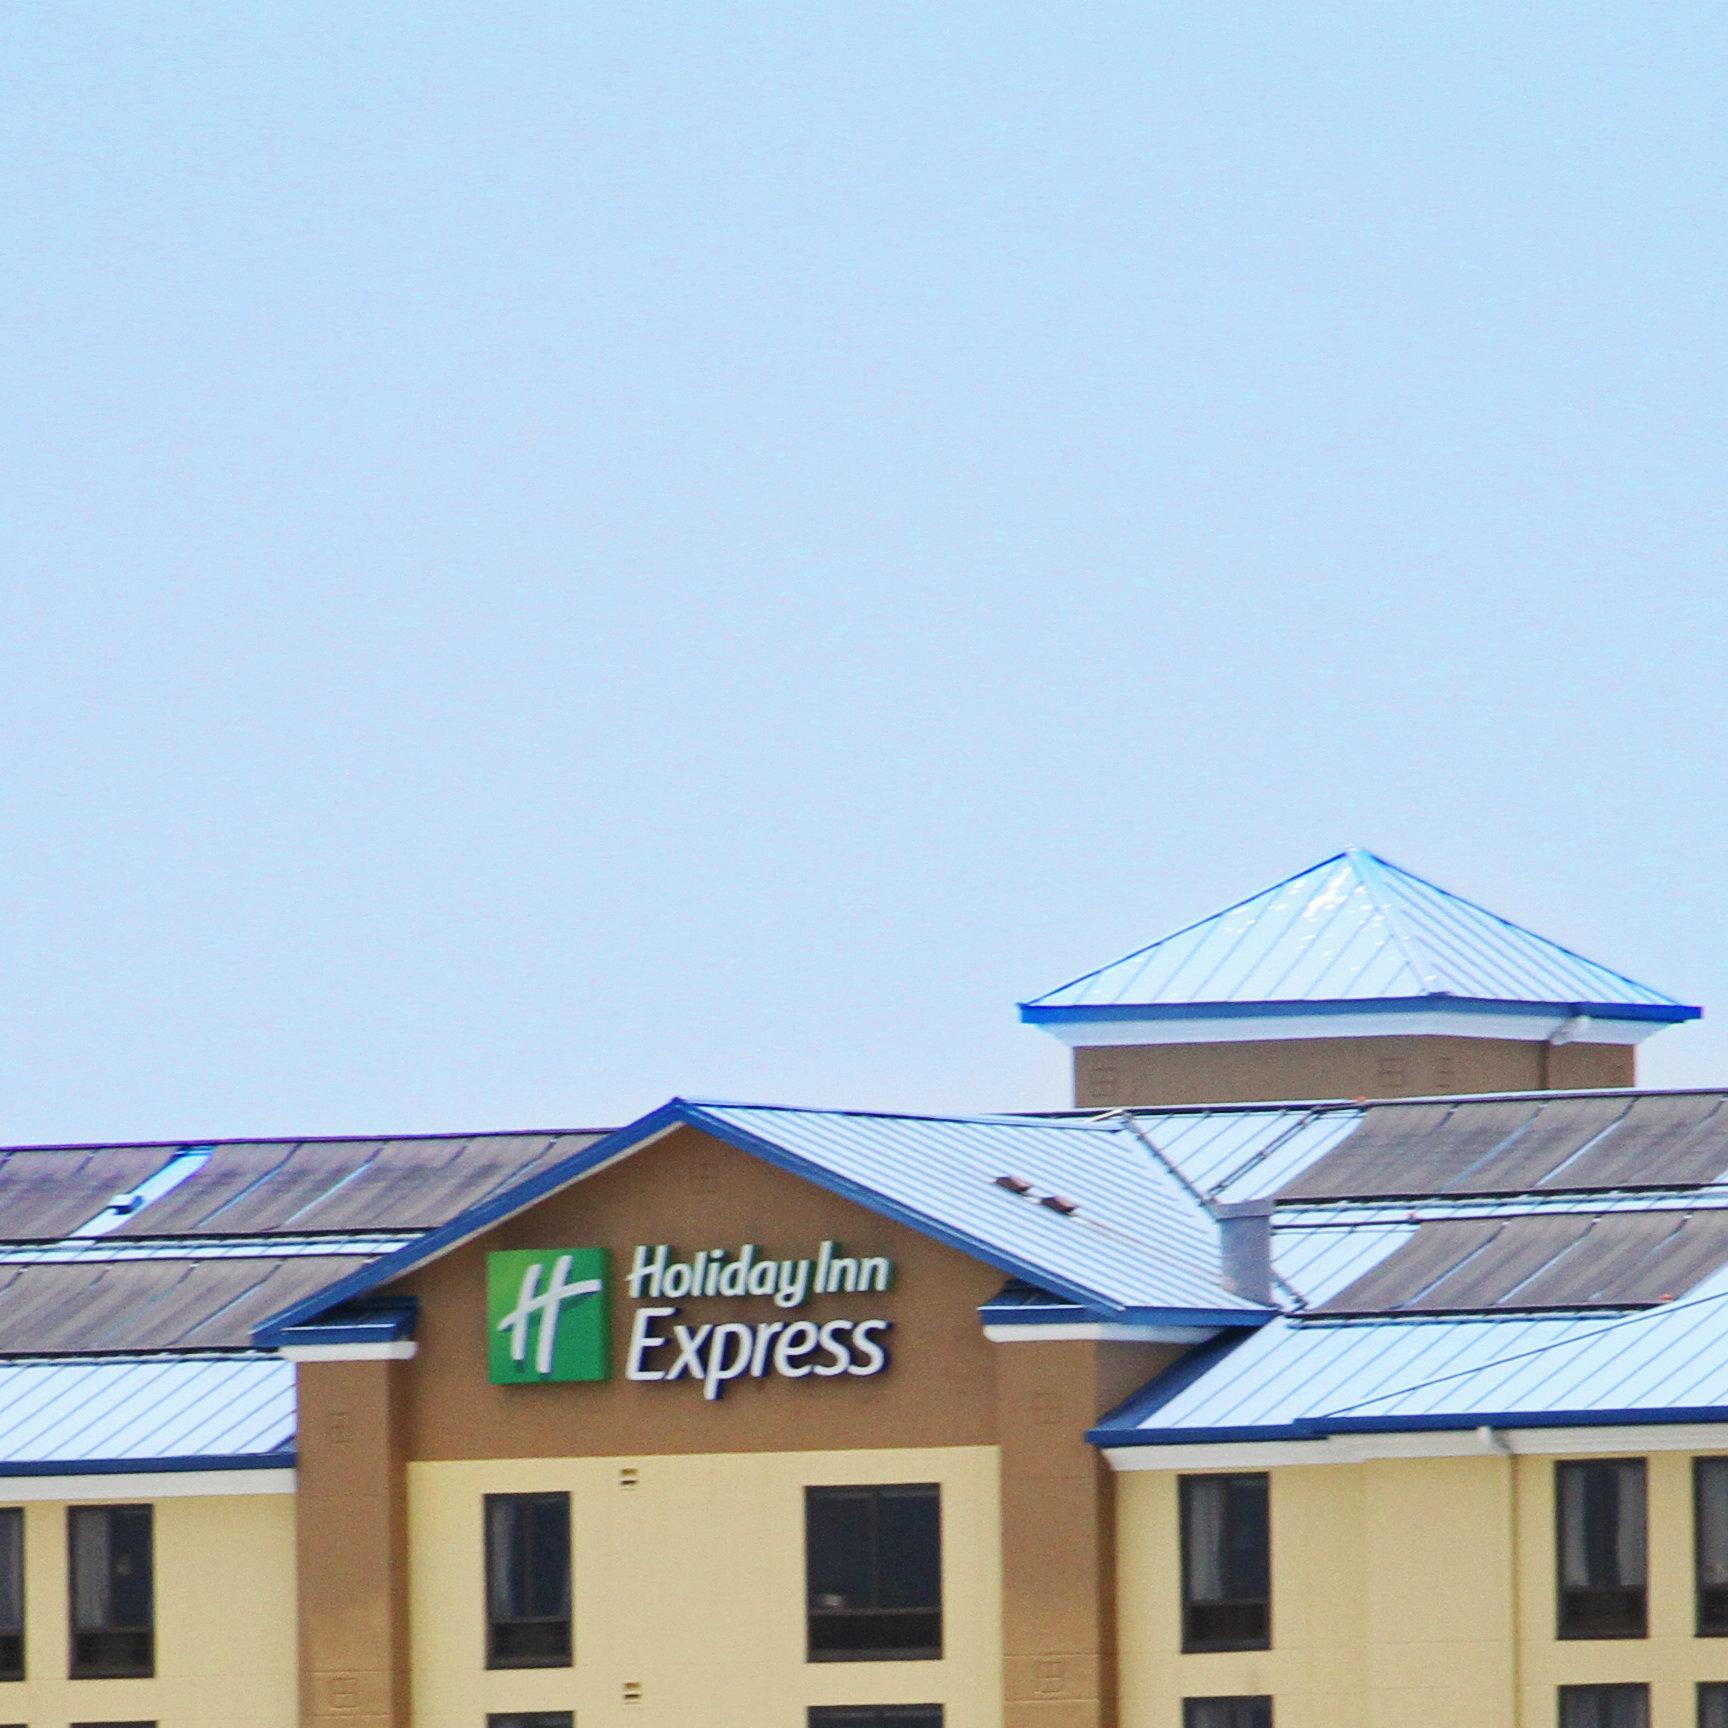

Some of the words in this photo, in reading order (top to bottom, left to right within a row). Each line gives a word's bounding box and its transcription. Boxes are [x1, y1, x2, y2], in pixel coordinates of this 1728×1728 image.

[497, 1255, 602, 1374] H
[626, 1244, 809, 1307] Holiday
[813, 1240, 890, 1293] Inn
[626, 1307, 889, 1400] Express
